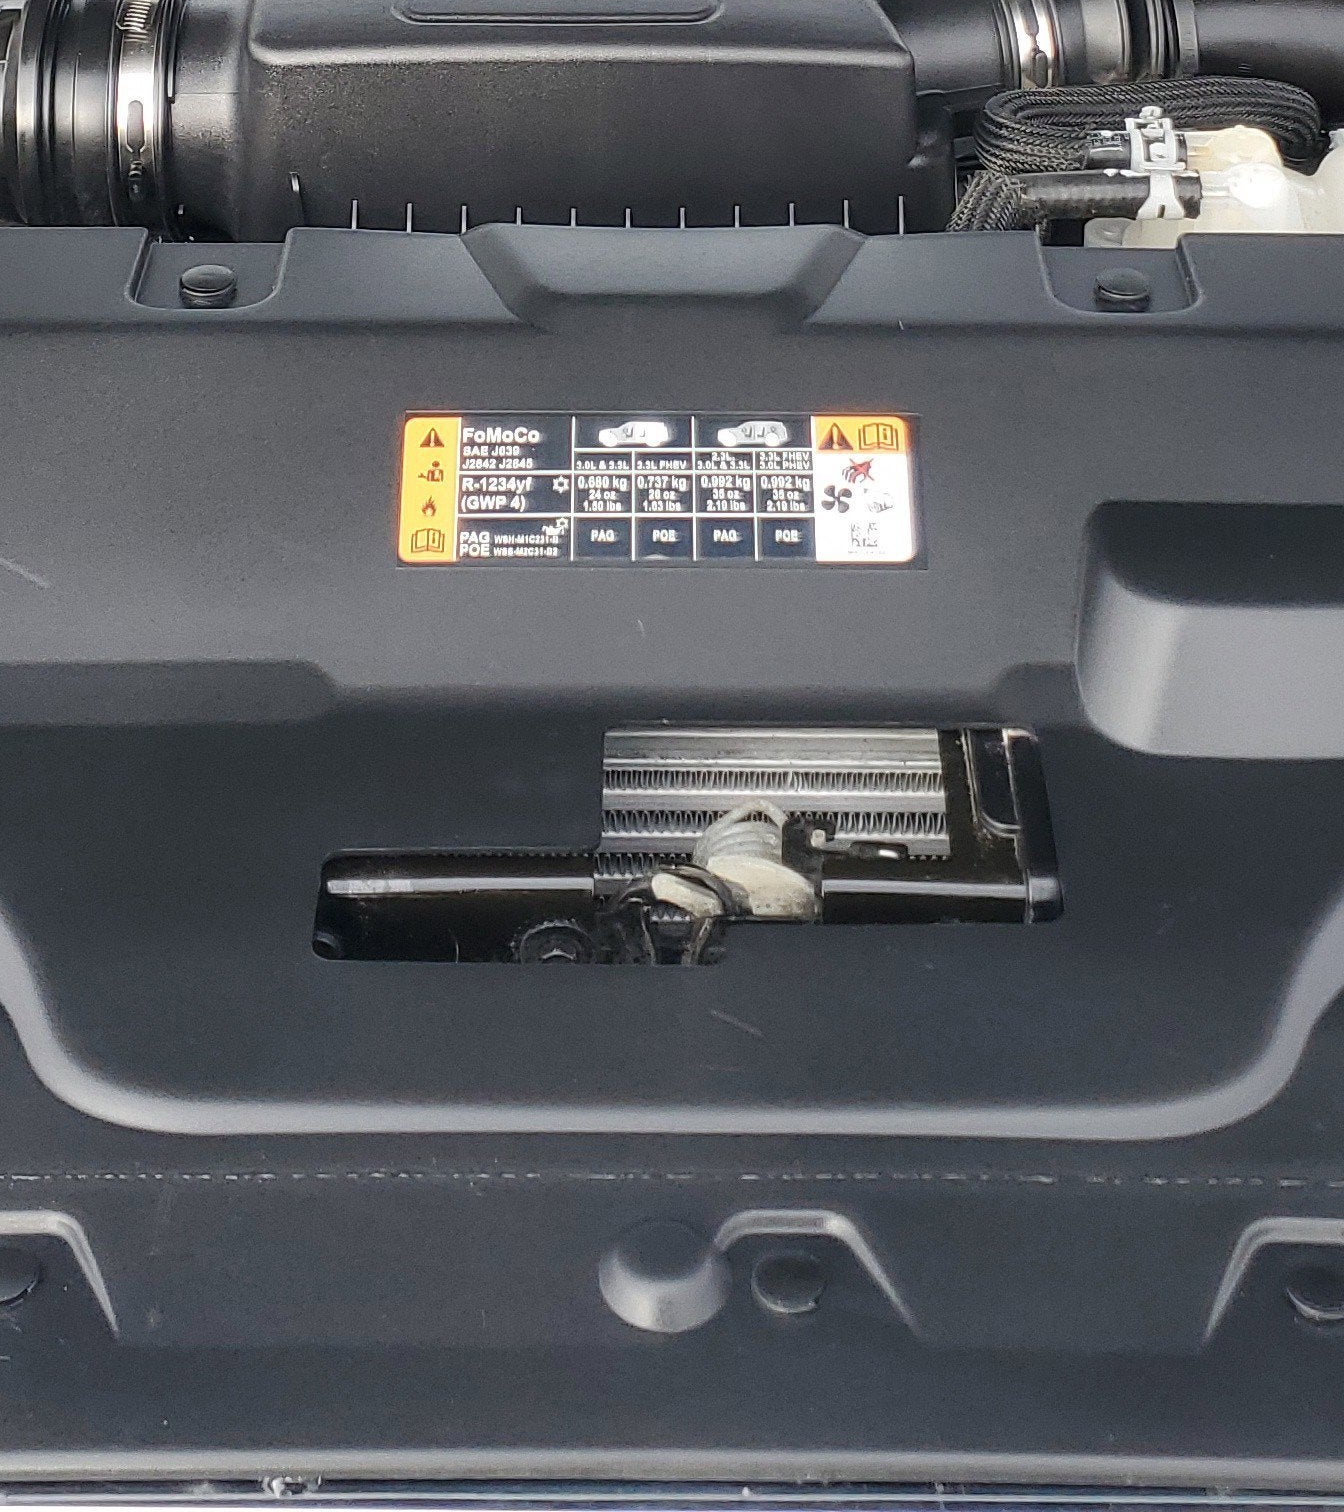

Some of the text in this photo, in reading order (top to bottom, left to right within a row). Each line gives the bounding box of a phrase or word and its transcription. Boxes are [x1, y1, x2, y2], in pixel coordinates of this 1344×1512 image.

[462, 427, 540, 443] FoMoCo
[462, 446, 489, 456] SAE
[461, 458, 497, 469] J2842
[576, 460, 597, 470] 3.0L
[697, 460, 717, 470] 3.0L
[461, 476, 533, 494] R-1234yf
[612, 475, 628, 492] kg
[637, 475, 688, 492] 0.737 kg
[735, 475, 751, 491] kg
[795, 476, 811, 491] kg
[588, 488, 617, 500] 24 oz
[663, 490, 676, 500] oz
[726, 490, 740, 500] oz
[786, 491, 800, 500] oz
[461, 495, 526, 512] (GWP 4)
[606, 500, 622, 512] lbs
[665, 500, 682, 512] lbs
[729, 499, 746, 511] lbs
[789, 500, 806, 512] lbs
[460, 531, 491, 544] PAG
[590, 529, 615, 542] PAG
[652, 529, 677, 542] POE
[713, 529, 737, 542] PAG
[775, 529, 799, 542] POE
[460, 544, 490, 557] POE
